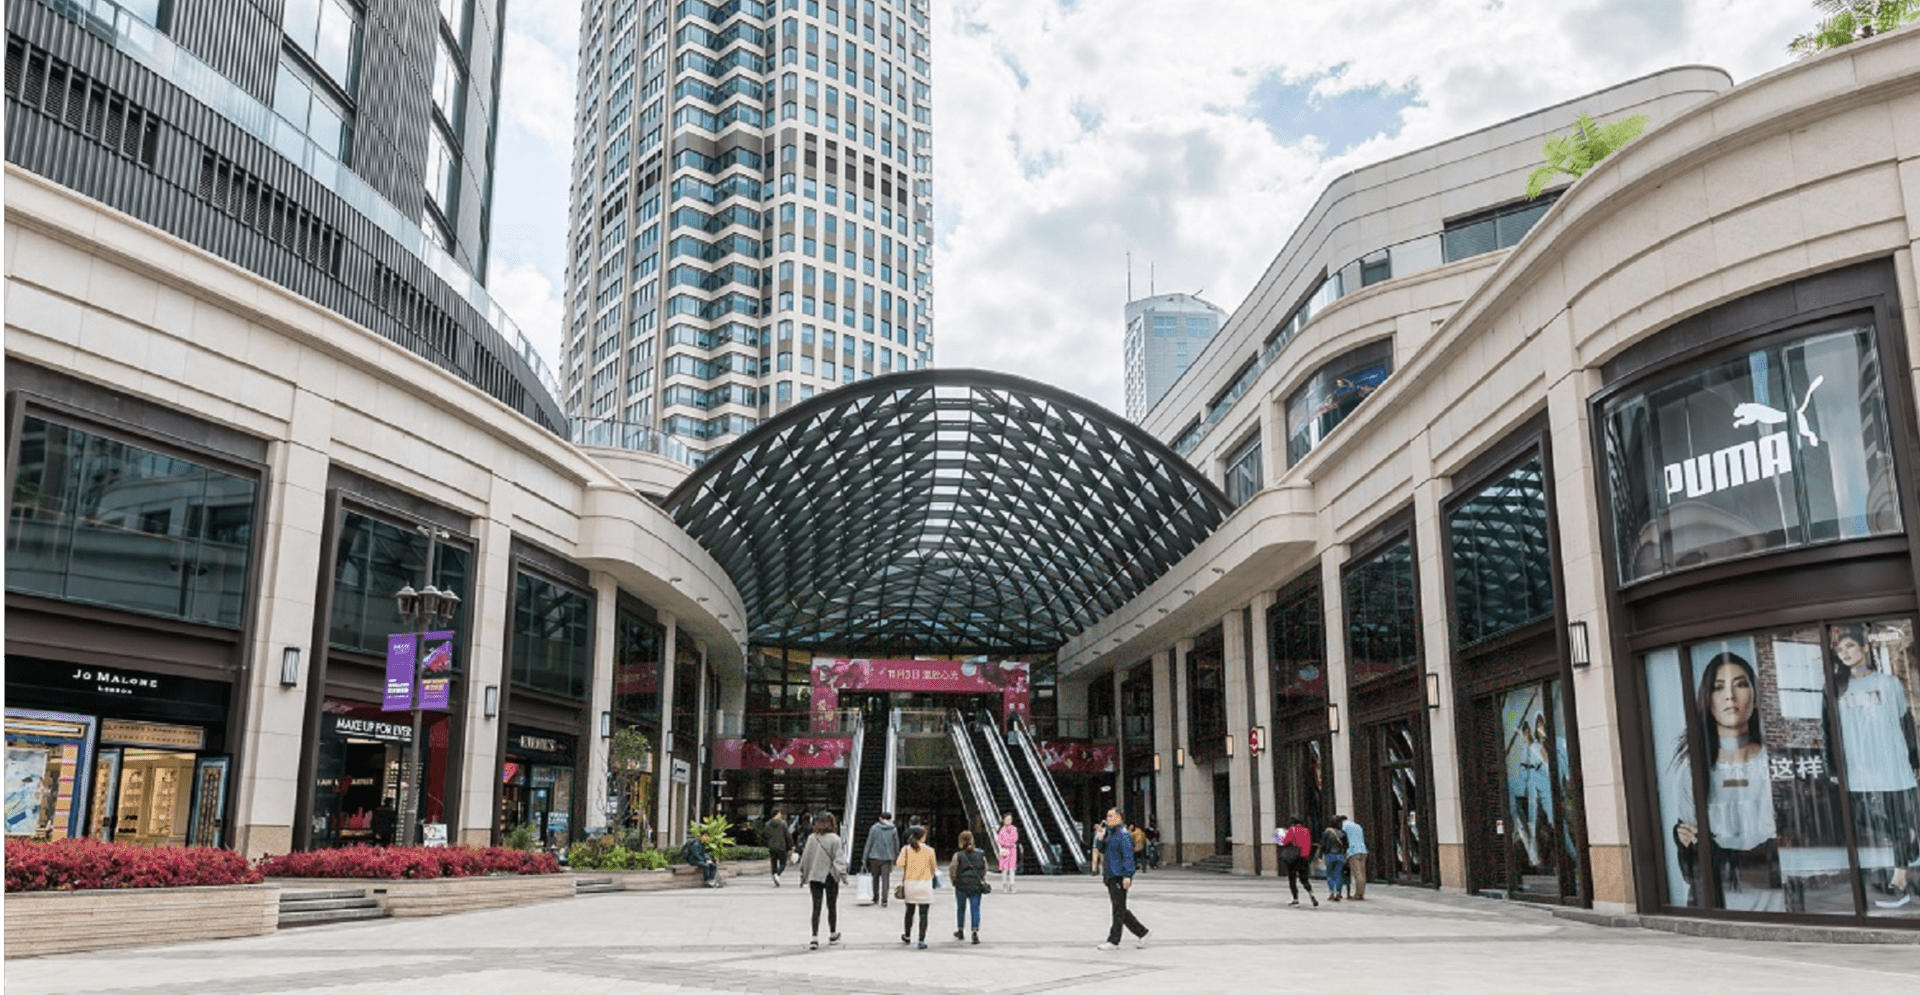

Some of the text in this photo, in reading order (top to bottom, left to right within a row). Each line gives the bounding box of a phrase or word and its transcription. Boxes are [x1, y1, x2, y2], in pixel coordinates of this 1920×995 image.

[1664, 430, 1792, 505] PUMA
[336, 718, 413, 737] MAKE UP FOR EVER
